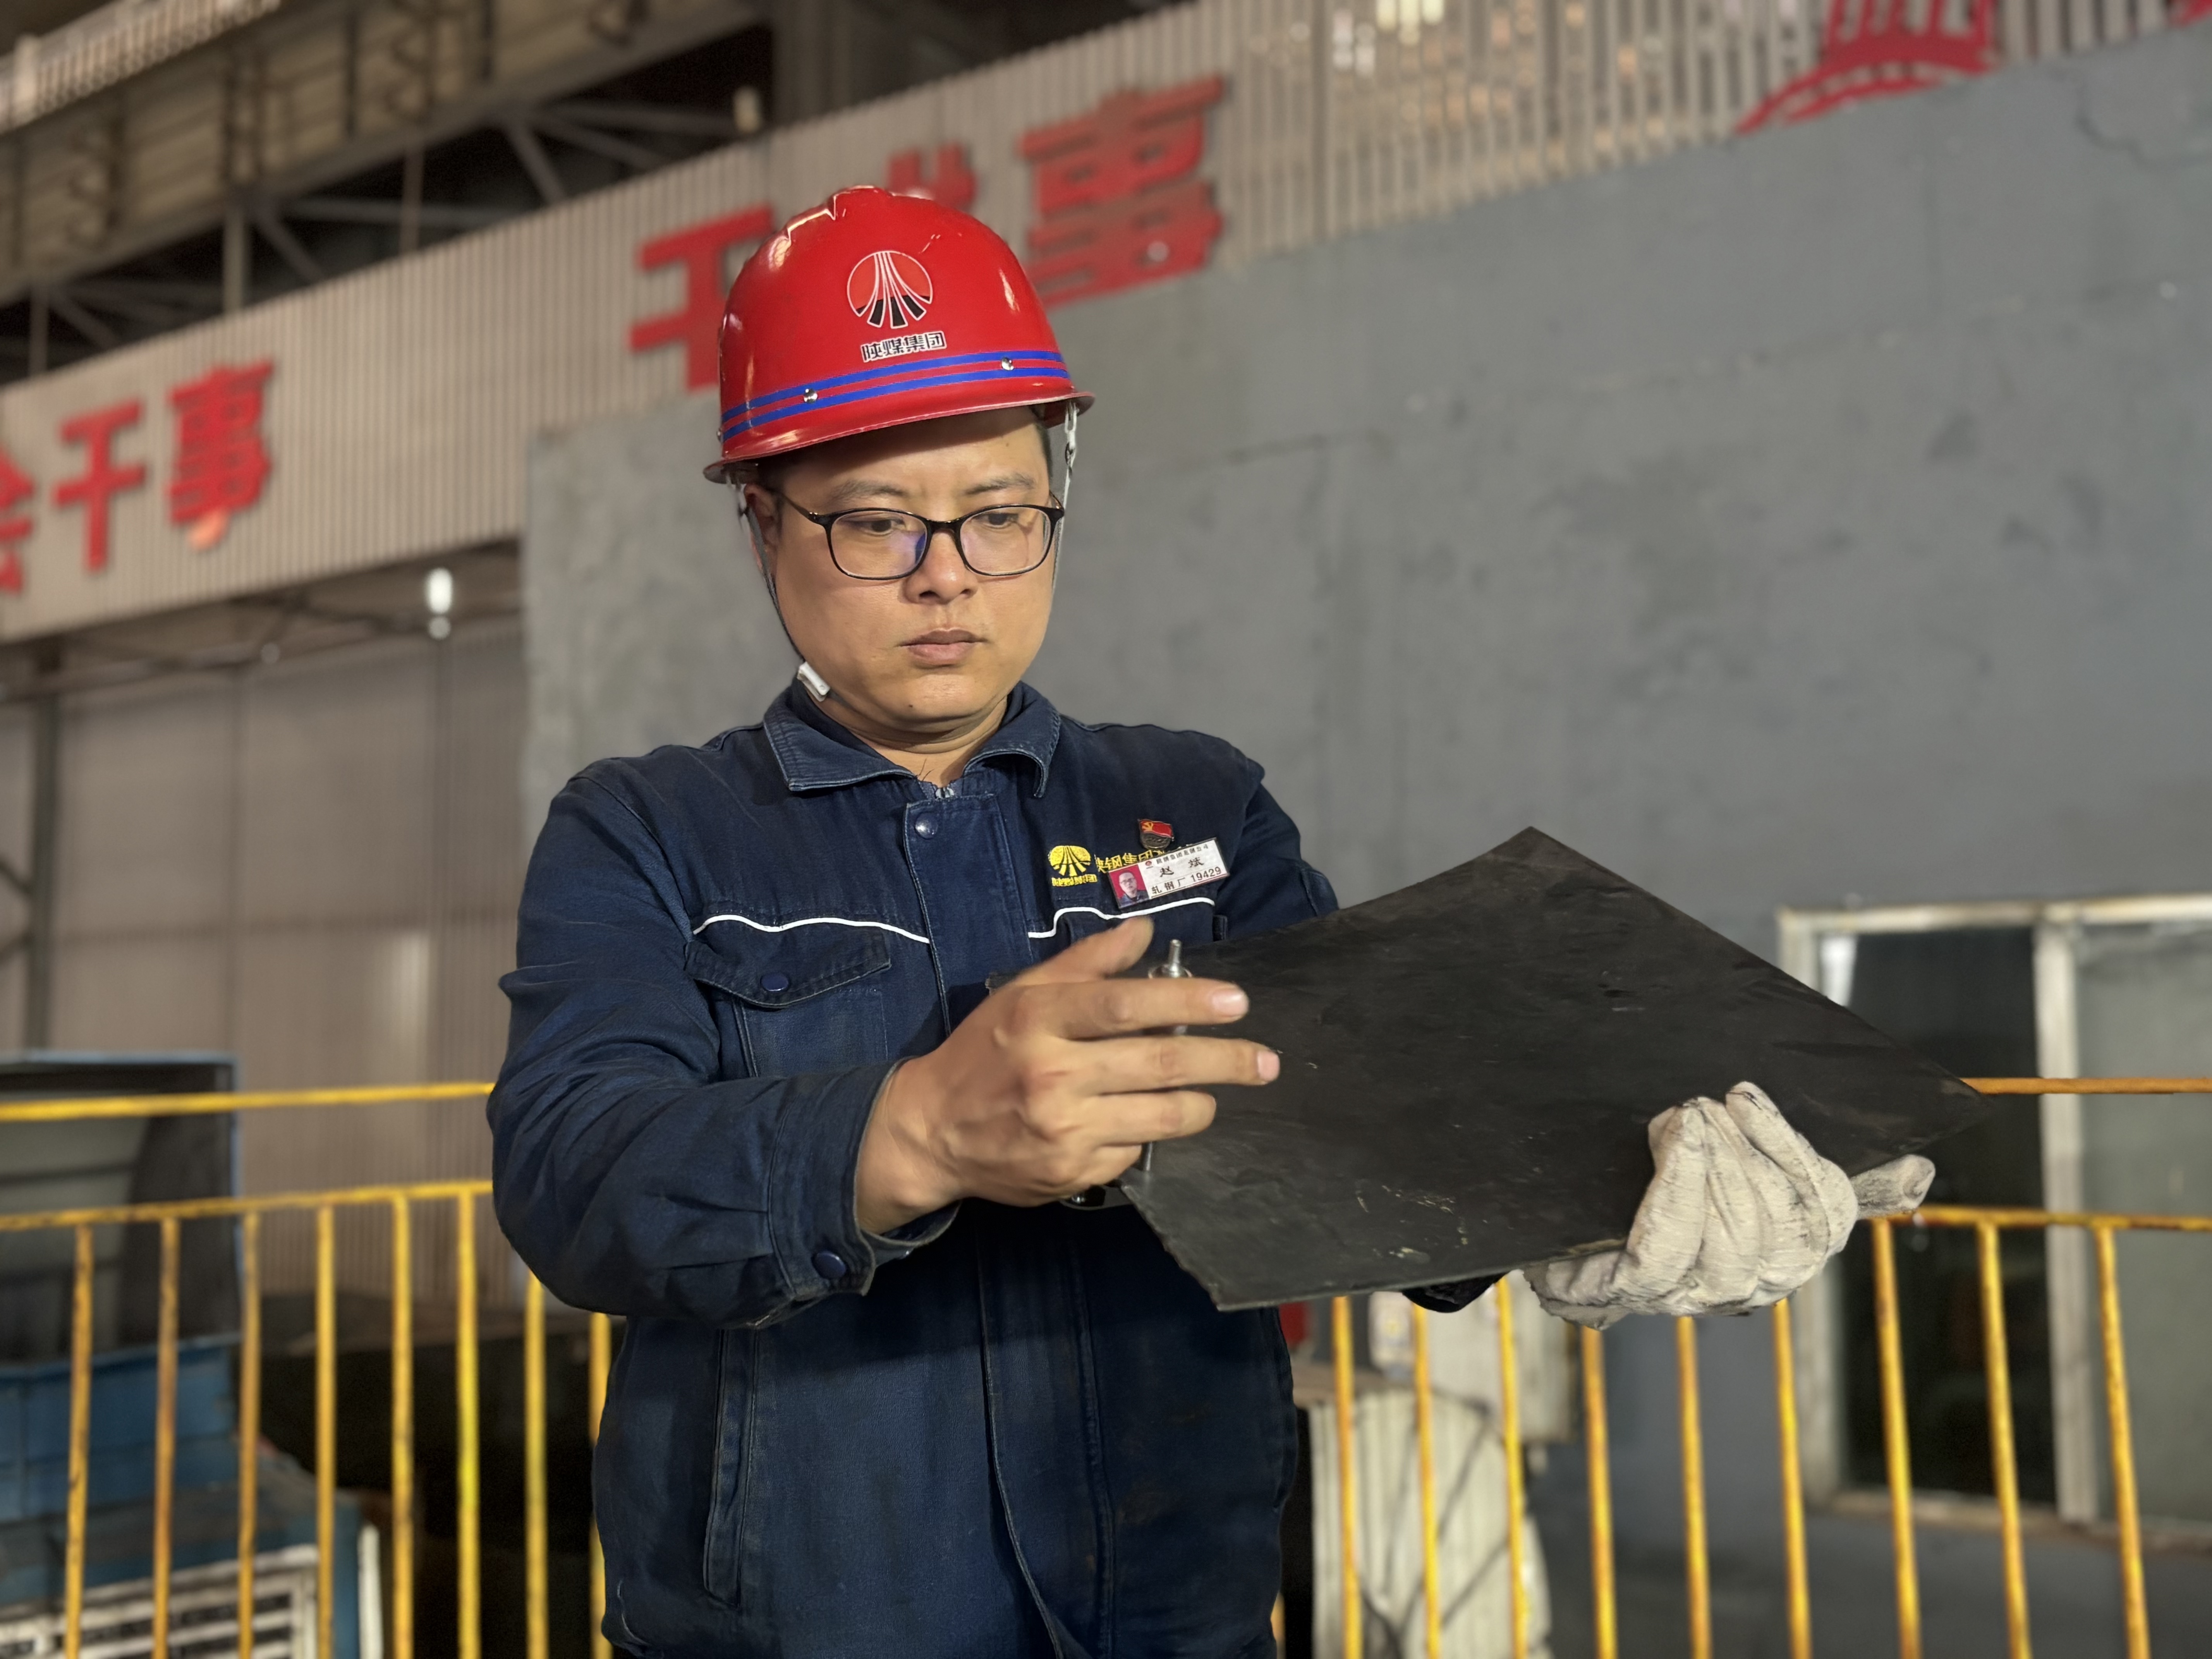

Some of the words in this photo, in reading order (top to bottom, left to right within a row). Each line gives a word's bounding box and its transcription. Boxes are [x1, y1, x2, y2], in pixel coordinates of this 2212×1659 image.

[628, 73, 1224, 391] 干事
[862, 331, 946, 362] 陕煤集团
[1190, 866, 1222, 882] 19429
